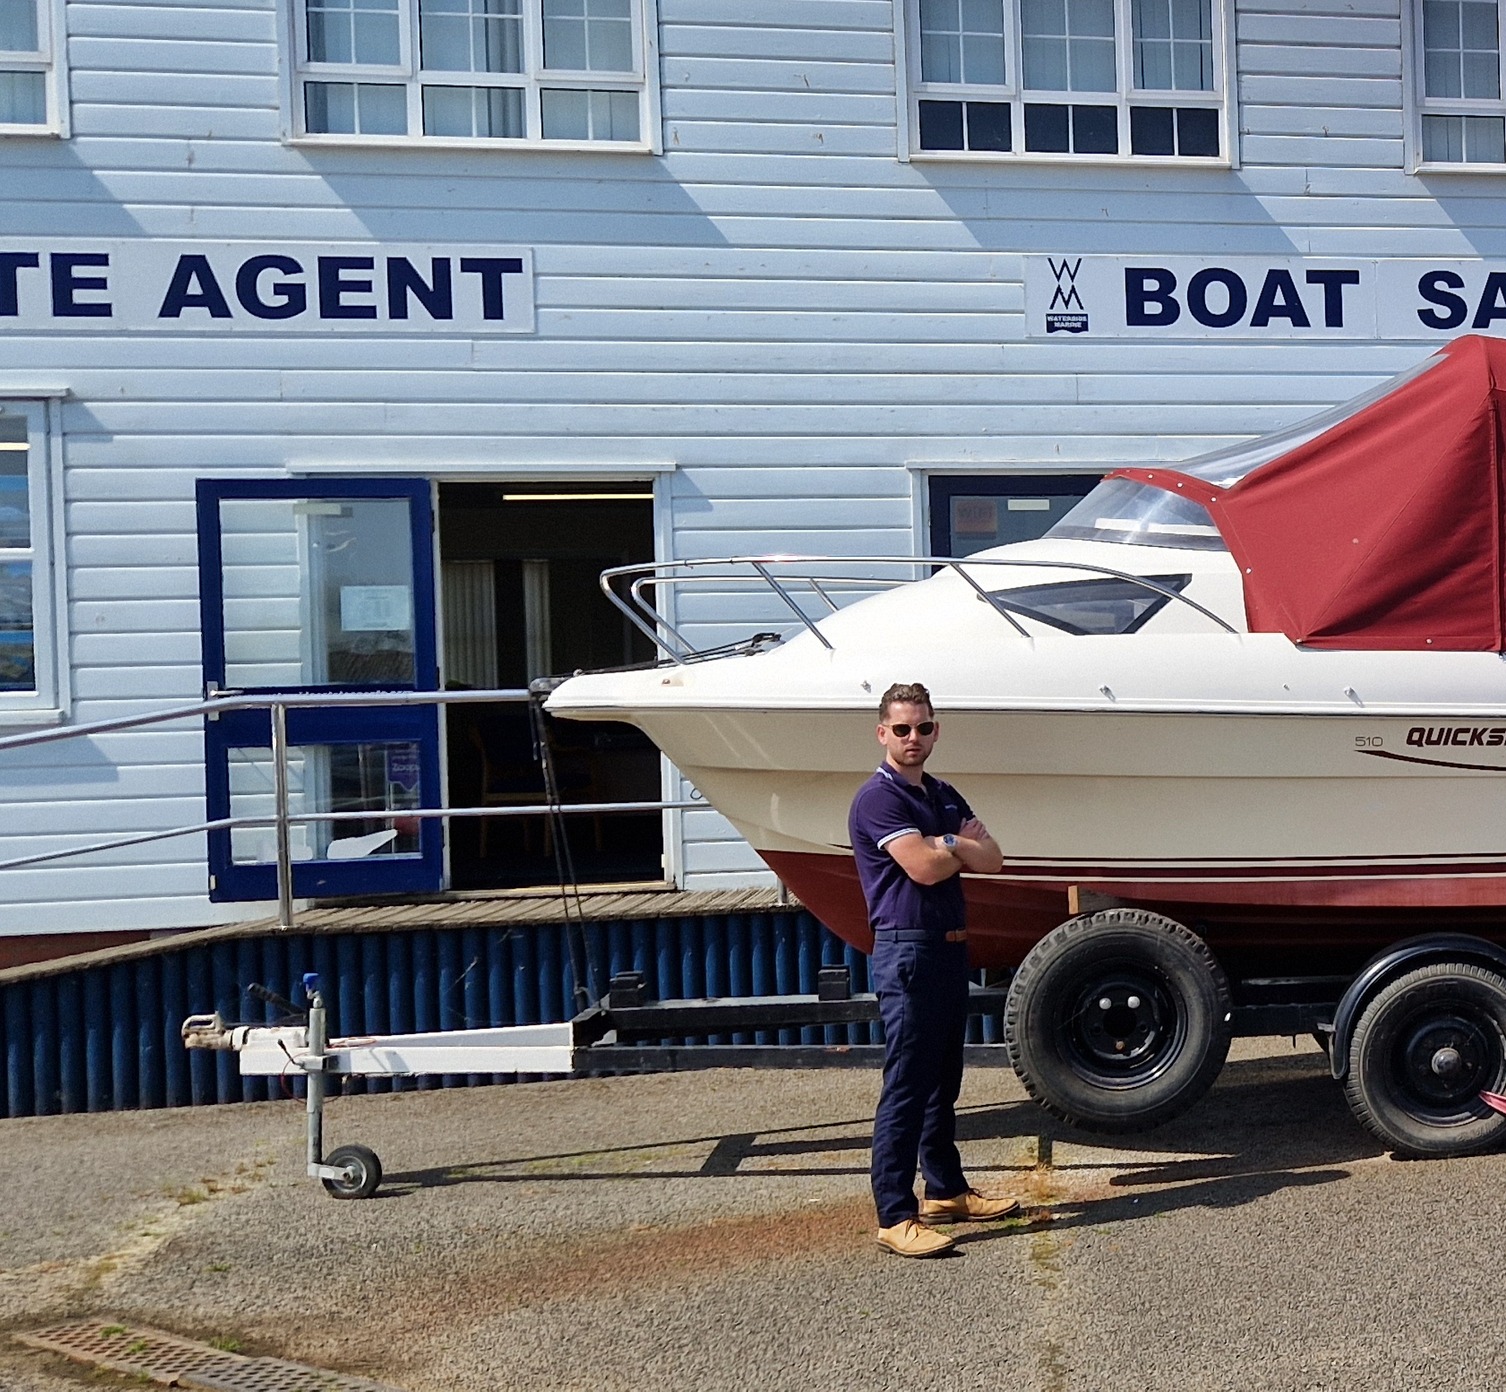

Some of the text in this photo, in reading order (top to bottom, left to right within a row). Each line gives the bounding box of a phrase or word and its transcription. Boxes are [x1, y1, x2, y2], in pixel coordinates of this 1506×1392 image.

[157, 254, 524, 320] AGENT
[1124, 267, 1360, 329] BOAT
[1354, 736, 1384, 747] 510
